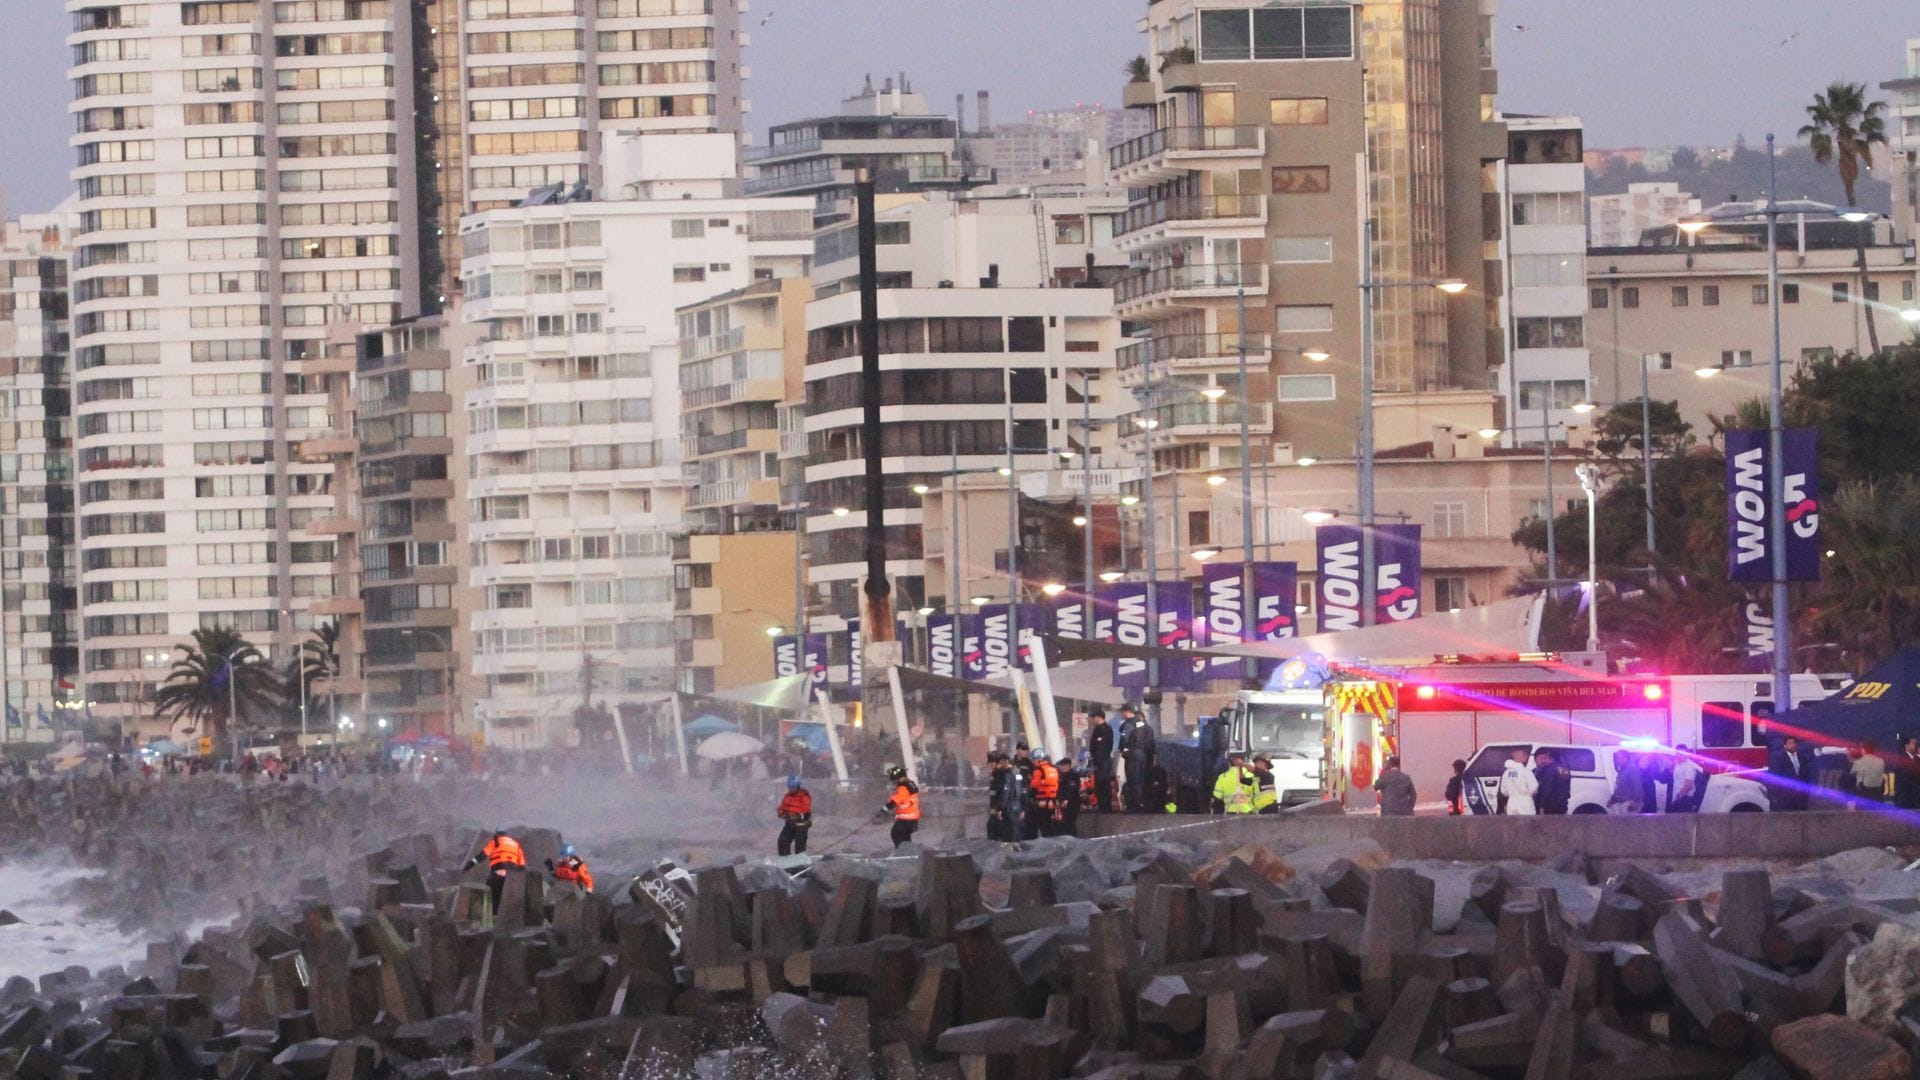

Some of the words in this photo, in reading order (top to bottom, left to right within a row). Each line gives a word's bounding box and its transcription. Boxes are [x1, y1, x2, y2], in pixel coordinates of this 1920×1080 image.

[1734, 448, 1765, 564] WOM
[1784, 473, 1818, 538] 5G
[1324, 541, 1359, 631] WOM
[1378, 563, 1417, 621] 5G
[777, 643, 797, 677] WO
[931, 624, 953, 678] WOM
[985, 614, 1009, 680] WOM
[1496, 687, 1507, 697] DE
[1509, 687, 1556, 697] BOMBEROS
[1557, 686, 1578, 695] VIÑA
[1579, 687, 1594, 695] DEL
[1597, 687, 1617, 695] MAR
[1845, 682, 1892, 699] PDI
